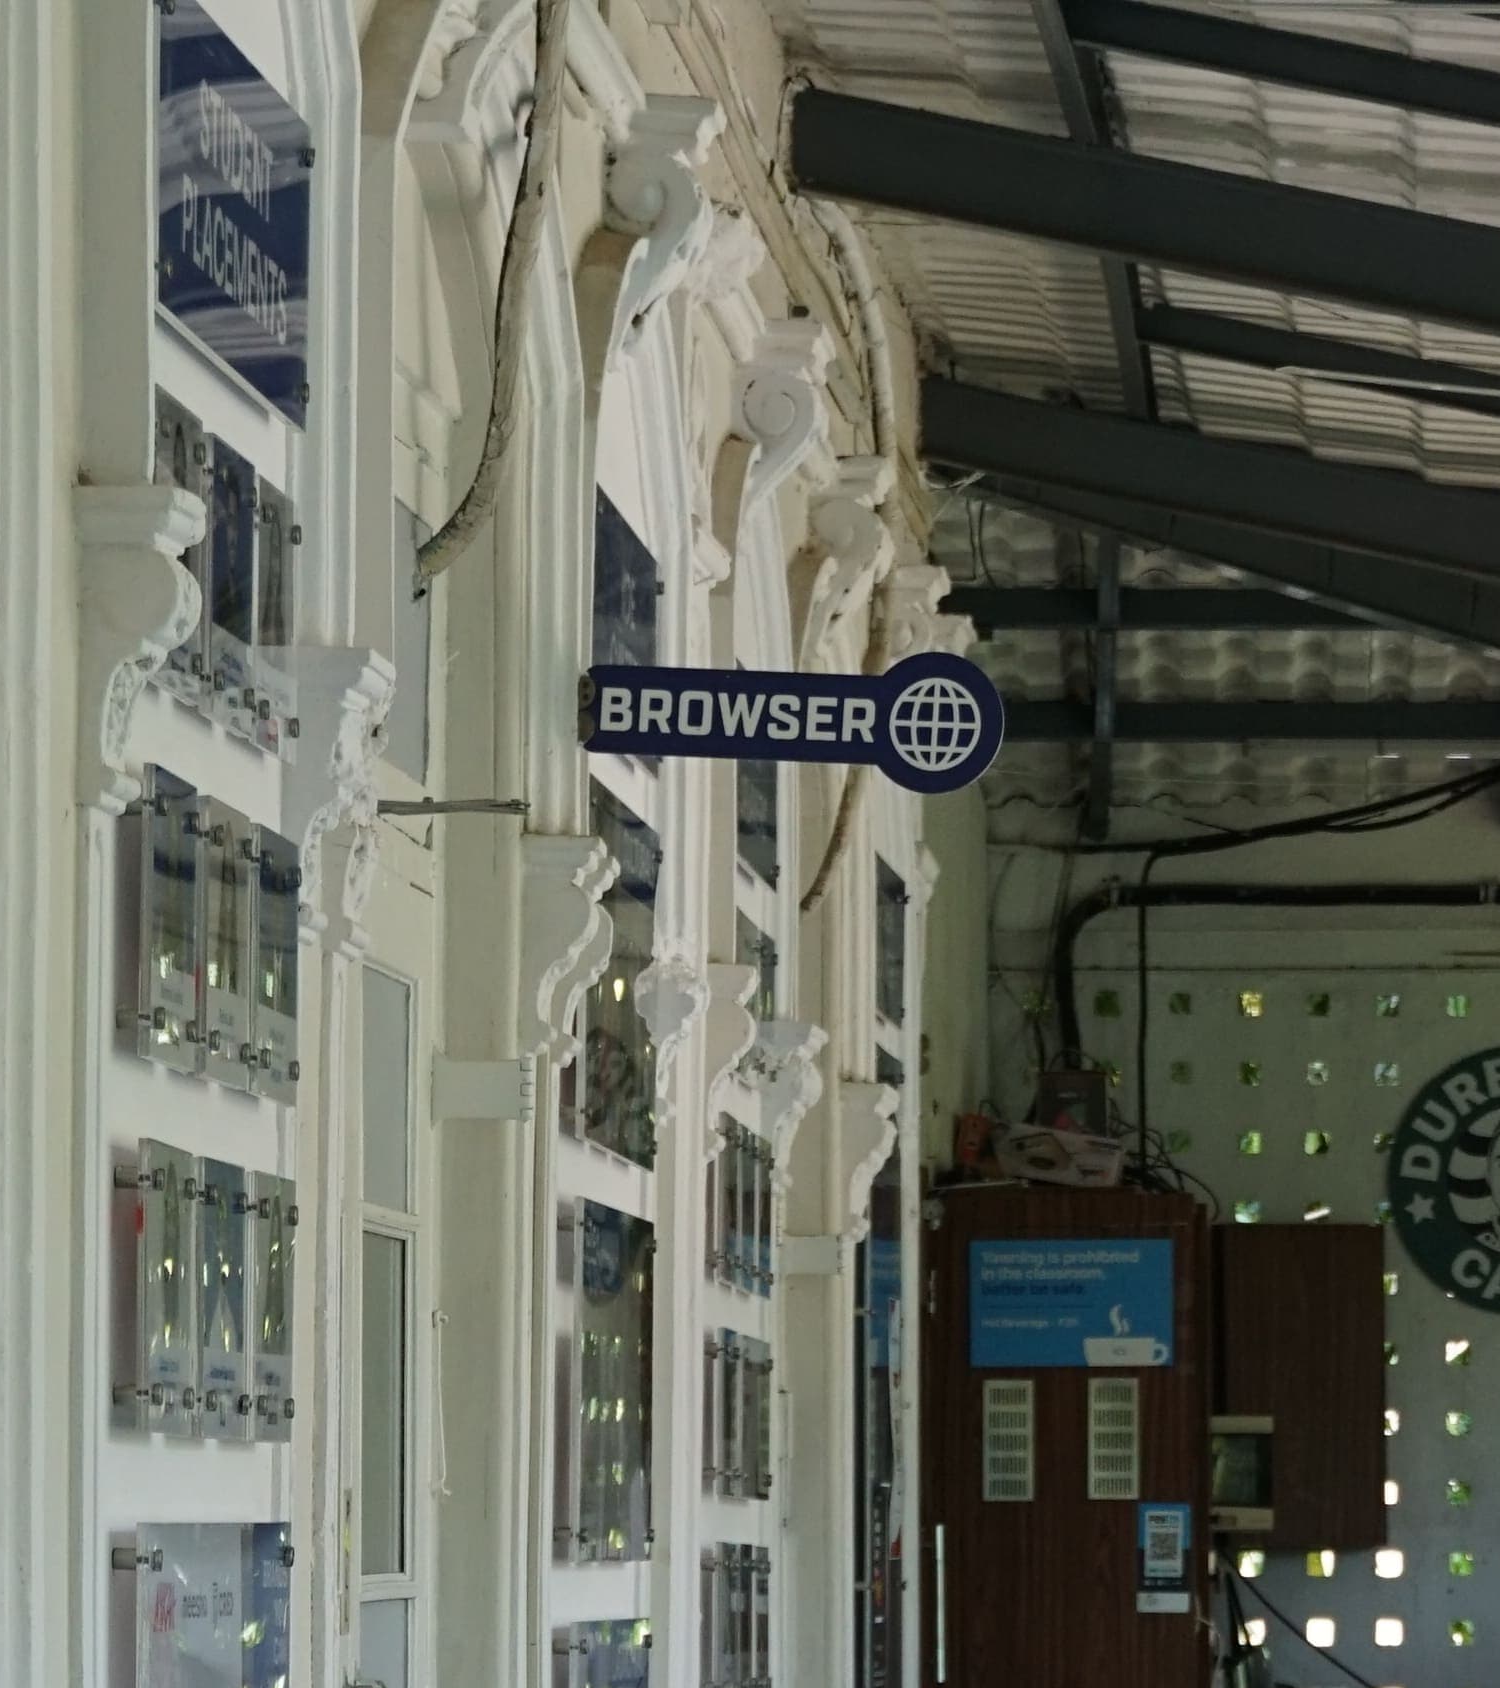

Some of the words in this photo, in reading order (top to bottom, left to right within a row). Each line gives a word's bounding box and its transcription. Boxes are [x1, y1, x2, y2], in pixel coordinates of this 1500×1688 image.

[200, 79, 273, 222] STUDENT
[182, 172, 288, 345] PLACEMENTS
[601, 687, 876, 743] BROWSER
